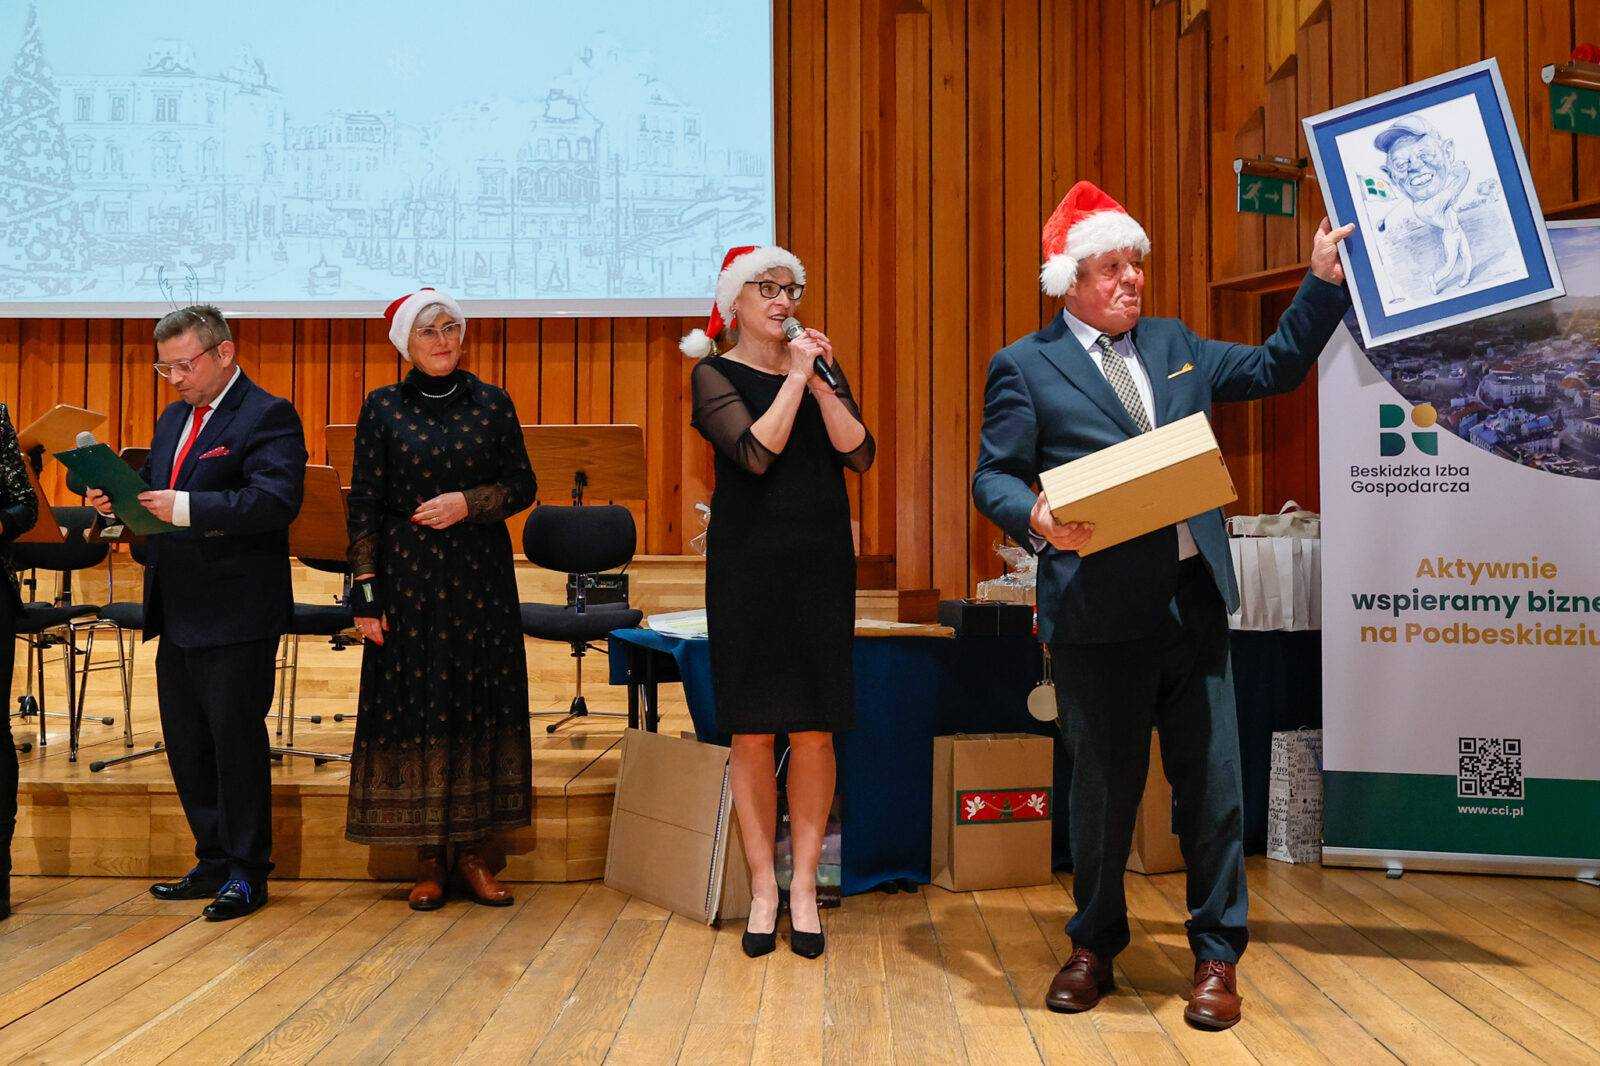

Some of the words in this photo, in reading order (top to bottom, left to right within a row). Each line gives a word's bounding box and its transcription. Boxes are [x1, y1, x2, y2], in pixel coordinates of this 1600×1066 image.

[1350, 464, 1430, 477] Beskidzka
[1435, 464, 1470, 477] Izba
[1351, 480, 1470, 497] Gospodarcza
[1416, 556, 1558, 585] Aktywnie
[1351, 588, 1520, 619] wspieramy
[1360, 625, 1397, 643] na
[1457, 805, 1524, 819] www.cci.pl
